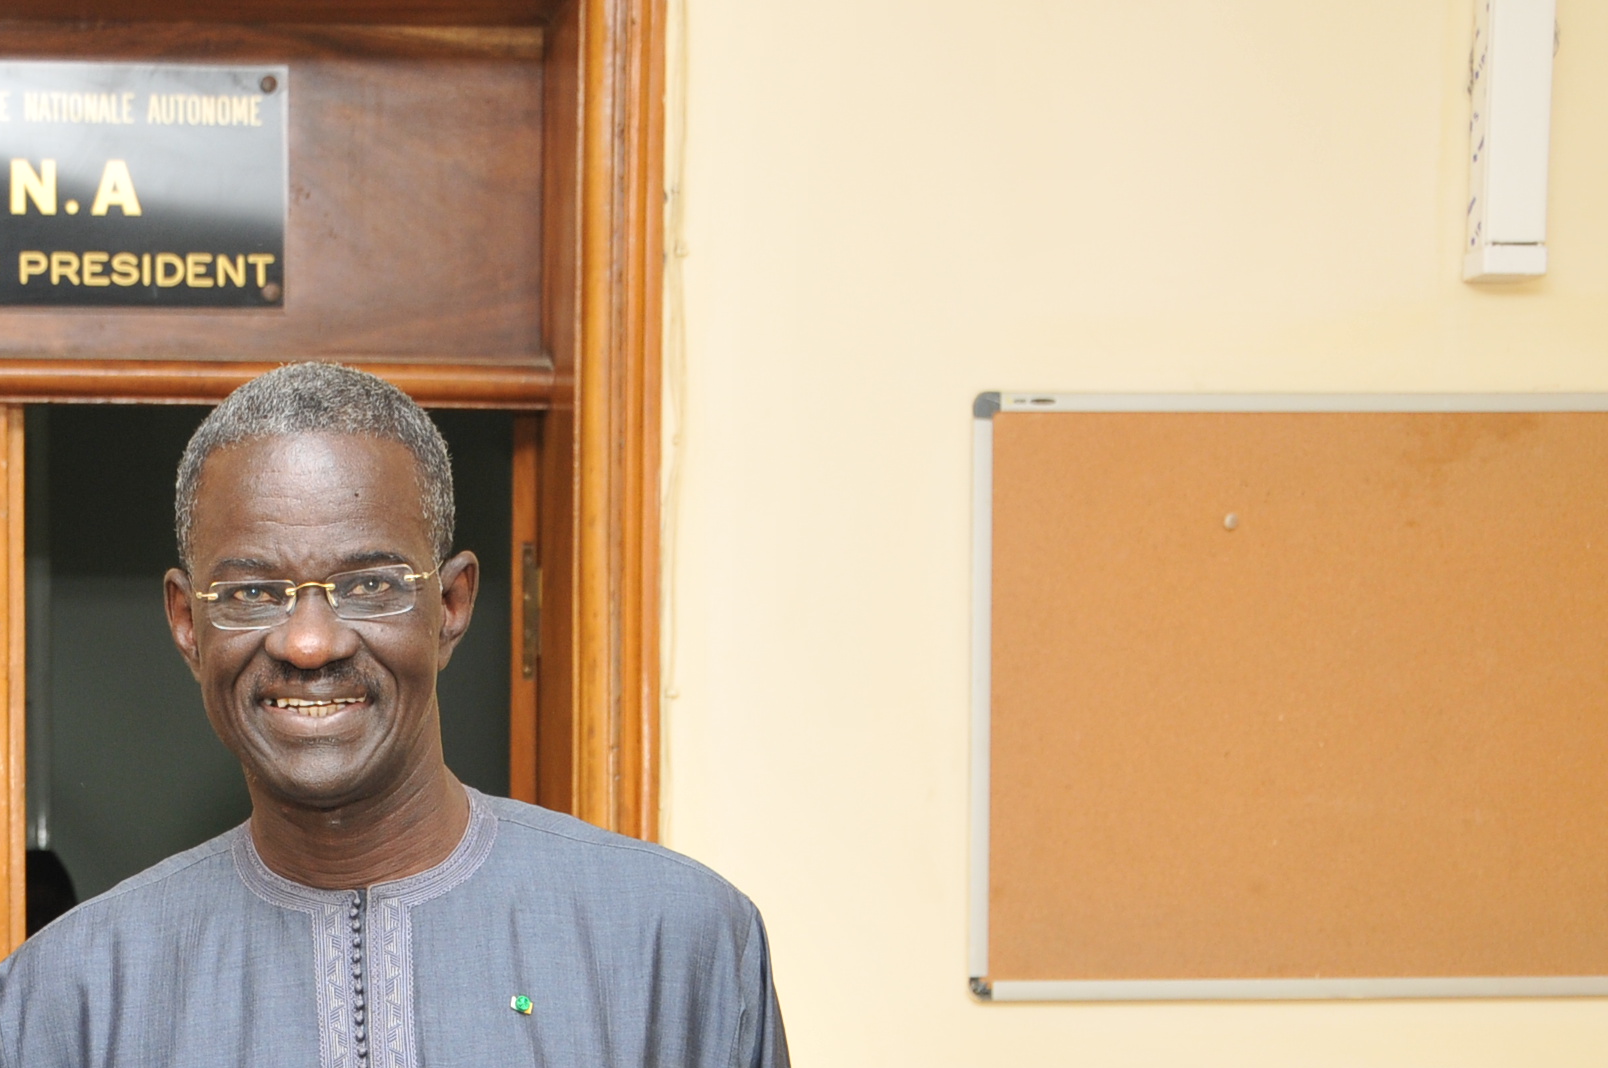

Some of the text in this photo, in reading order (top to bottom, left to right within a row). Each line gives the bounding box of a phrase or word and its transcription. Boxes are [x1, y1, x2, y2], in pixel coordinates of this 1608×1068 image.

[25, 92, 134, 124] NATIONALE
[148, 94, 261, 126] AUTONOME
[19, 252, 275, 288] PRESIDENT
